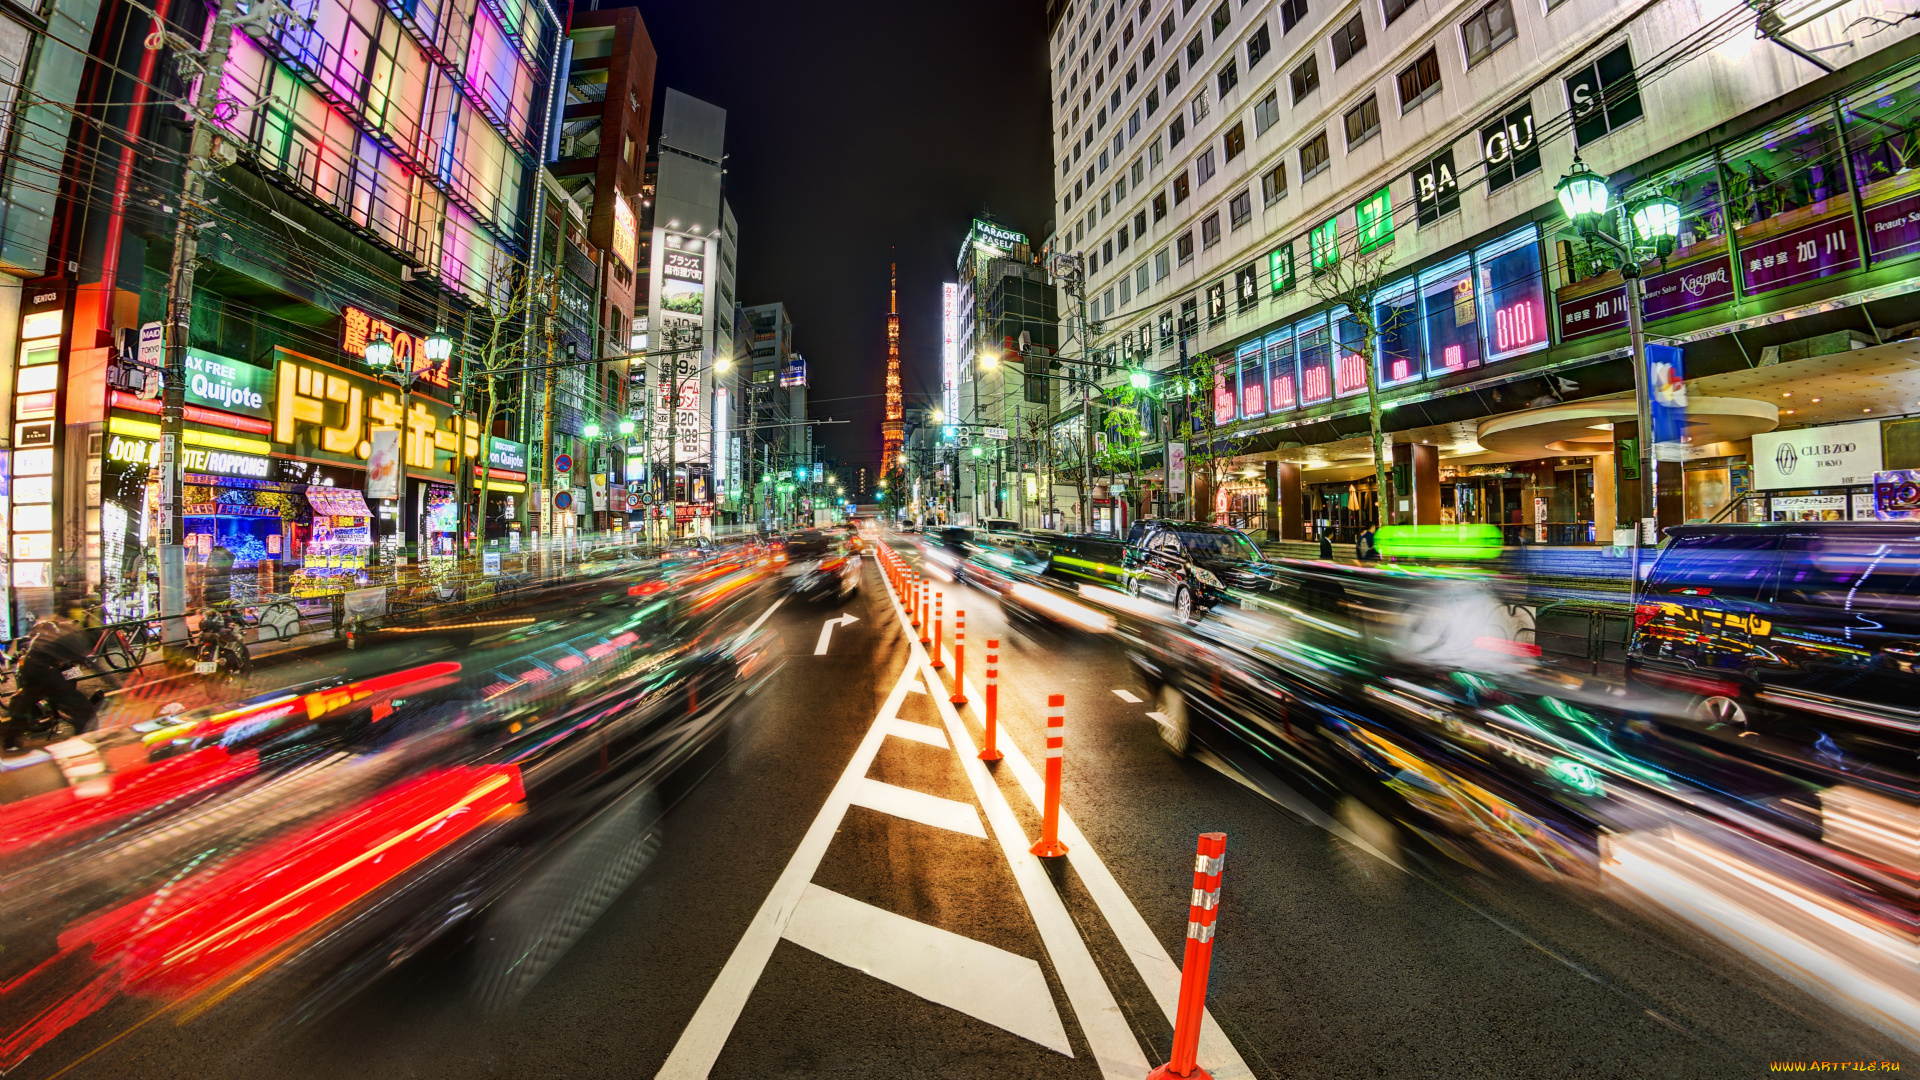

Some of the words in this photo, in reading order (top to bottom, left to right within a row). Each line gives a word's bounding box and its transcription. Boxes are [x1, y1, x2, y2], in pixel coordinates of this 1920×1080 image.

[977, 222, 1022, 242] KARAOKE
[1874, 216, 1907, 233] Beauty
[669, 254, 700, 269] ブランズ
[1750, 251, 1788, 273] 美容室
[1661, 284, 1677, 296] Salon
[1679, 266, 1730, 297] Kagawa
[1565, 308, 1591, 325] 美容室
[142, 329, 160, 339] MAID
[141, 344, 160, 355] TOKYO
[185, 355, 204, 371] AX
[205, 360, 236, 380] FREE
[191, 374, 263, 409] Quijote
[1802, 445, 1831, 456] CLUB
[1832, 442, 1856, 455] ZOO
[500, 453, 524, 469] Quijote
[1816, 460, 1842, 468] TOKYO
